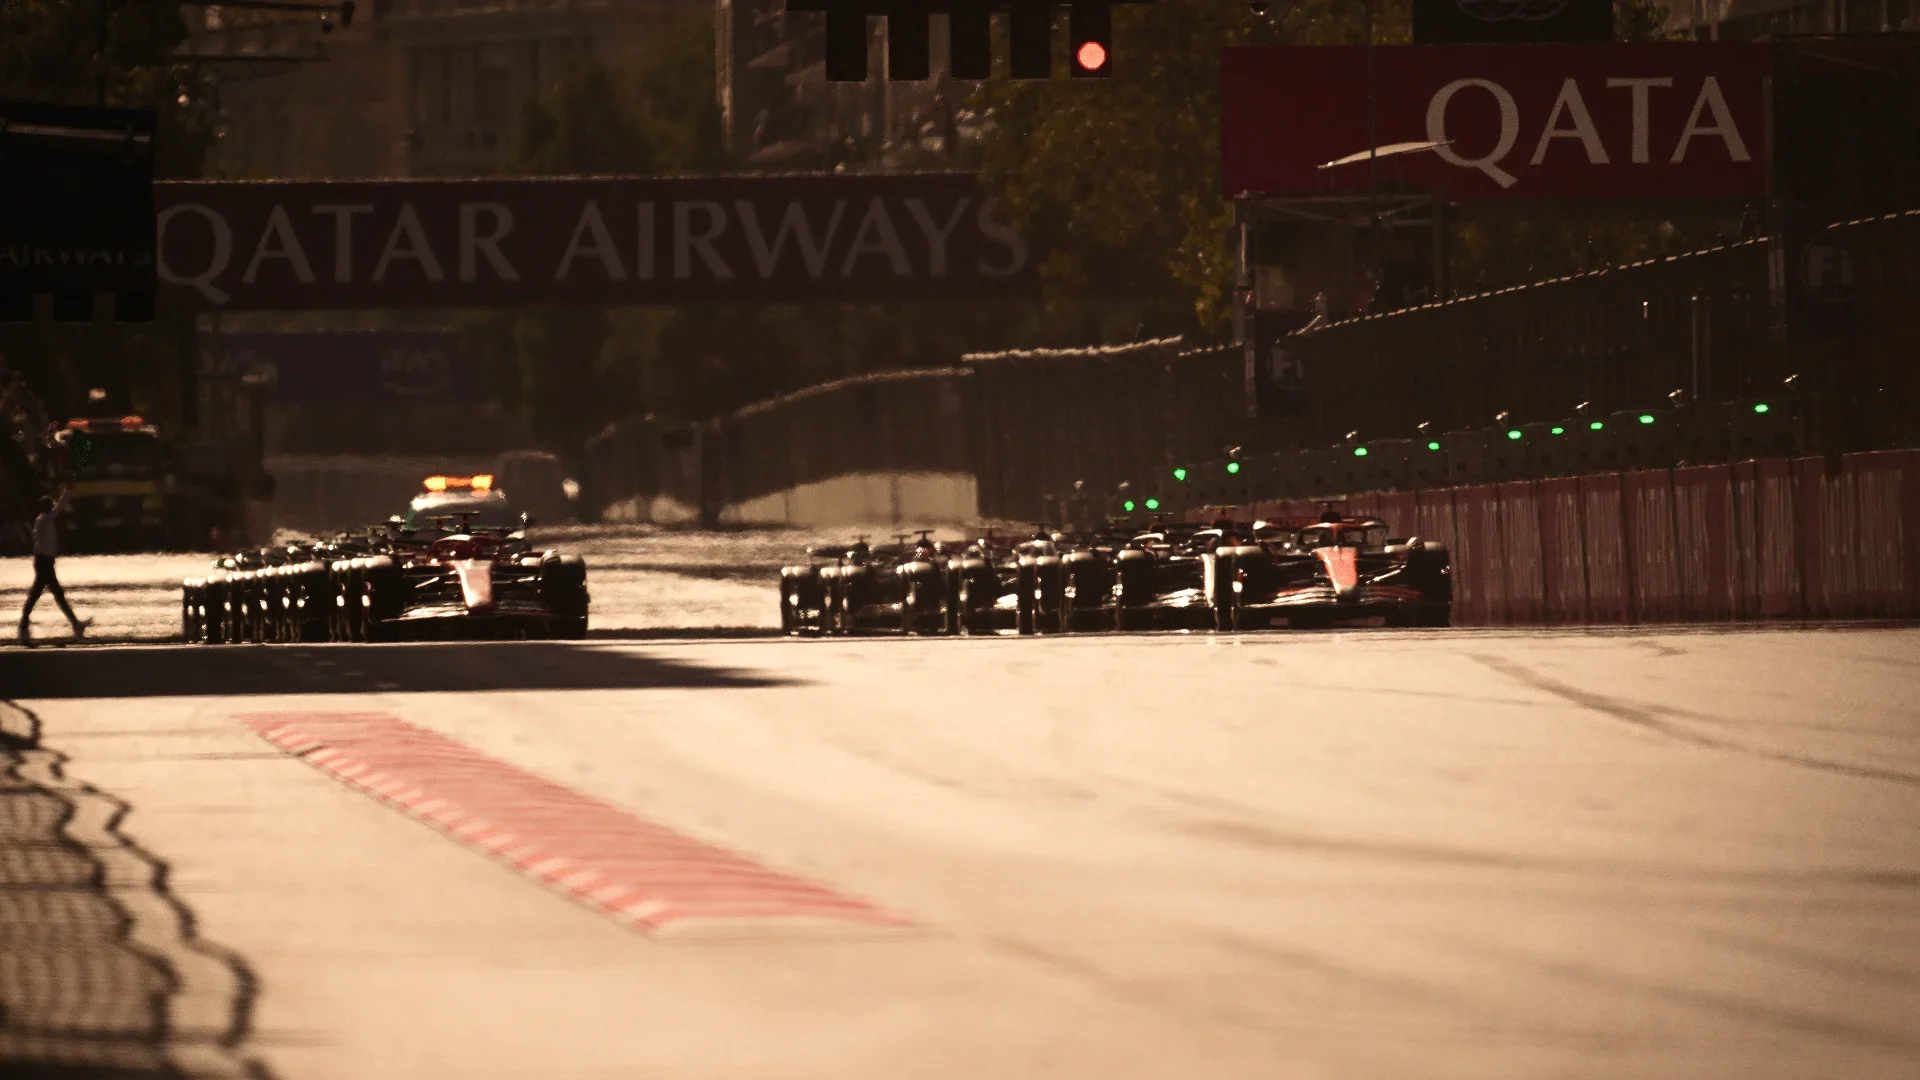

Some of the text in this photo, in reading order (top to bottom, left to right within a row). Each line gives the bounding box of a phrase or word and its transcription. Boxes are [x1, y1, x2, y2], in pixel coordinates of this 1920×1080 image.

[1424, 76, 1752, 189] QATA
[156, 196, 1029, 305] QATAR AIRWAYS
